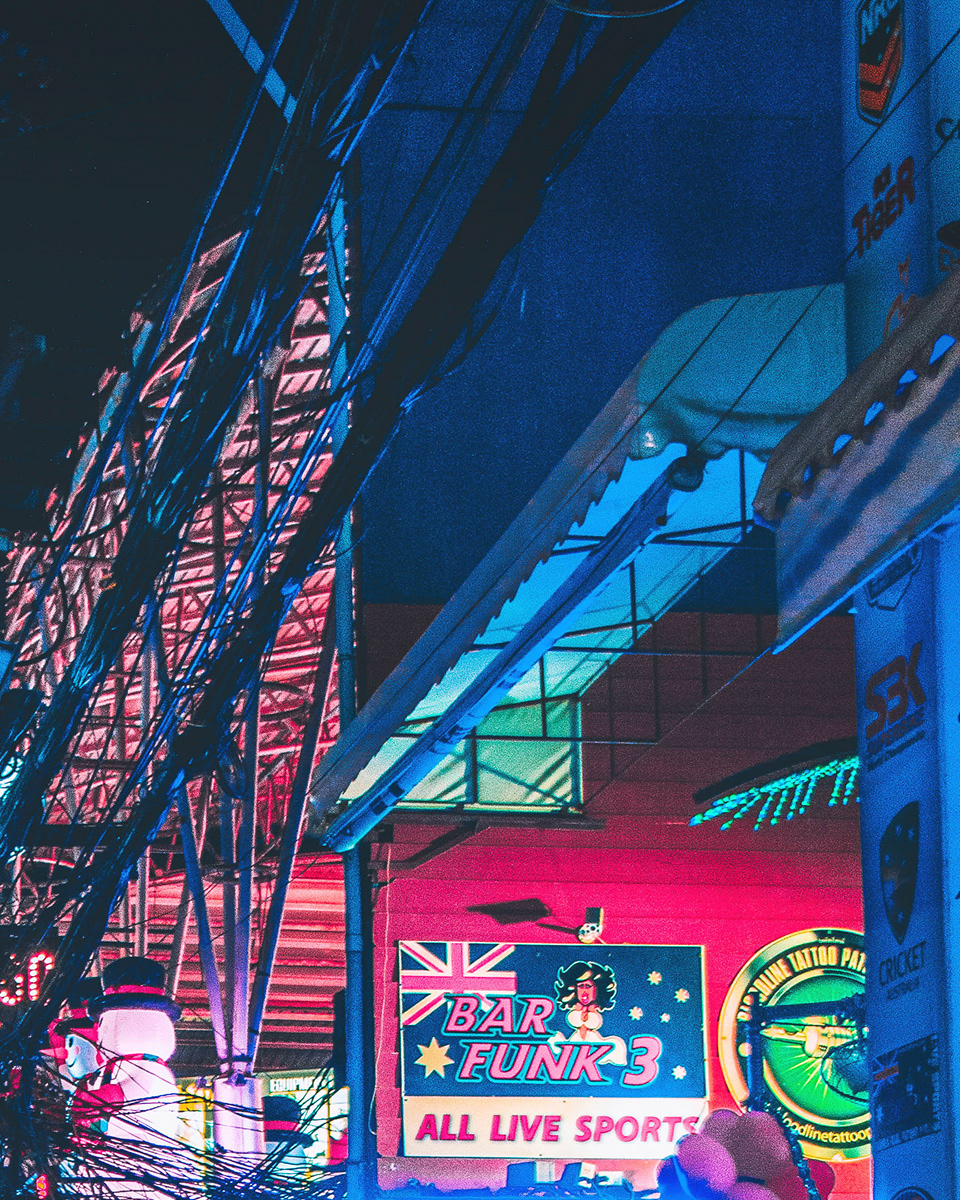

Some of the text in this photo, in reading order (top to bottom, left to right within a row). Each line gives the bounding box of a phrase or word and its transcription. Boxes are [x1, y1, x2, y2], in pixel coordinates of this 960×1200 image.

[786, 945, 840, 972] TATTOO
[878, 940, 927, 986] CRICKET
[442, 993, 555, 1036] BAR
[457, 1035, 664, 1087] FUNK 3
[415, 1114, 700, 1144] ALL LIVE SPORTS
